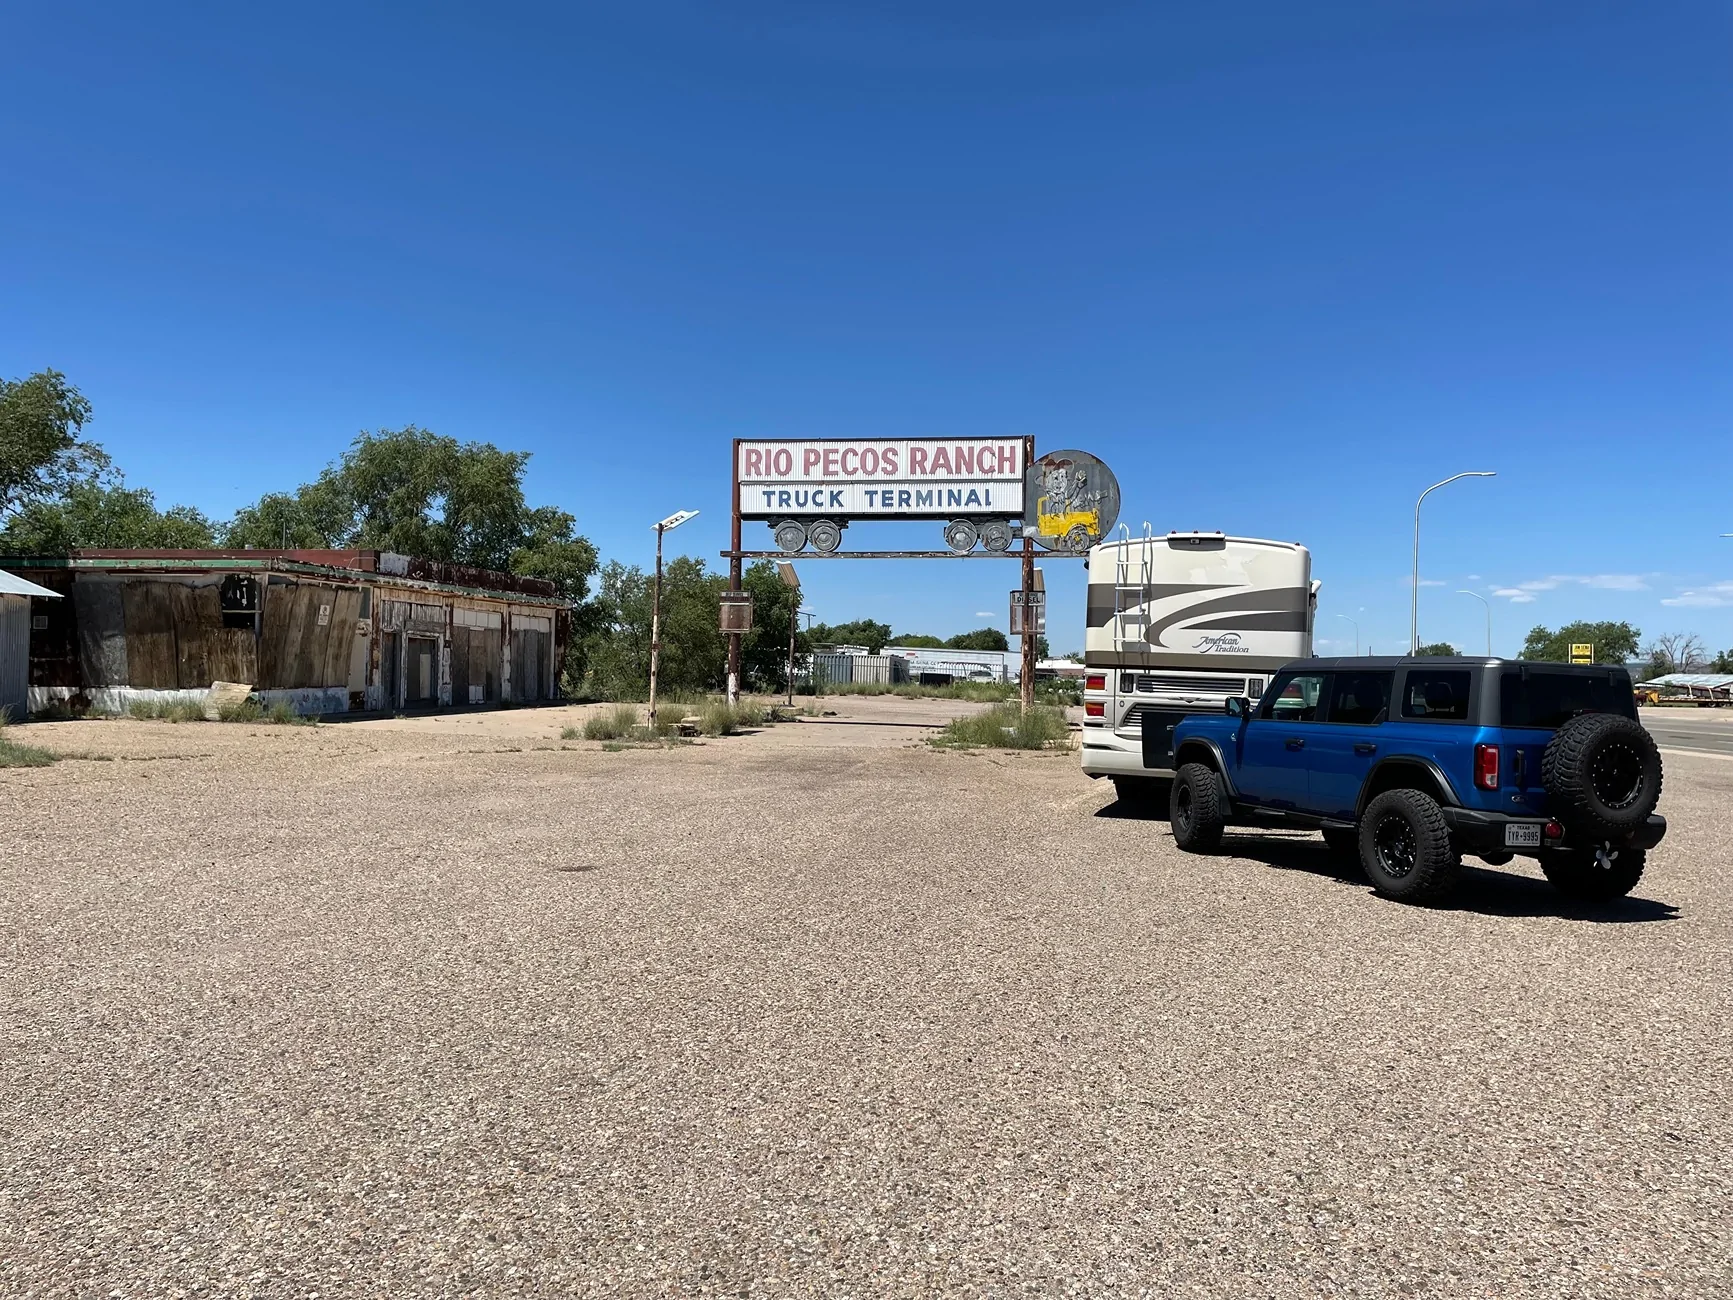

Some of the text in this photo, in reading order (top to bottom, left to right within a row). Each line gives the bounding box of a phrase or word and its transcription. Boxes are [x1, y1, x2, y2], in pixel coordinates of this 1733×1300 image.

[745, 446, 1016, 477] RIO PECOS RANCH
[762, 489, 992, 508] TRUCK TERMINAL
[1192, 635, 1240, 648] American
[1214, 645, 1249, 653] Tradition
